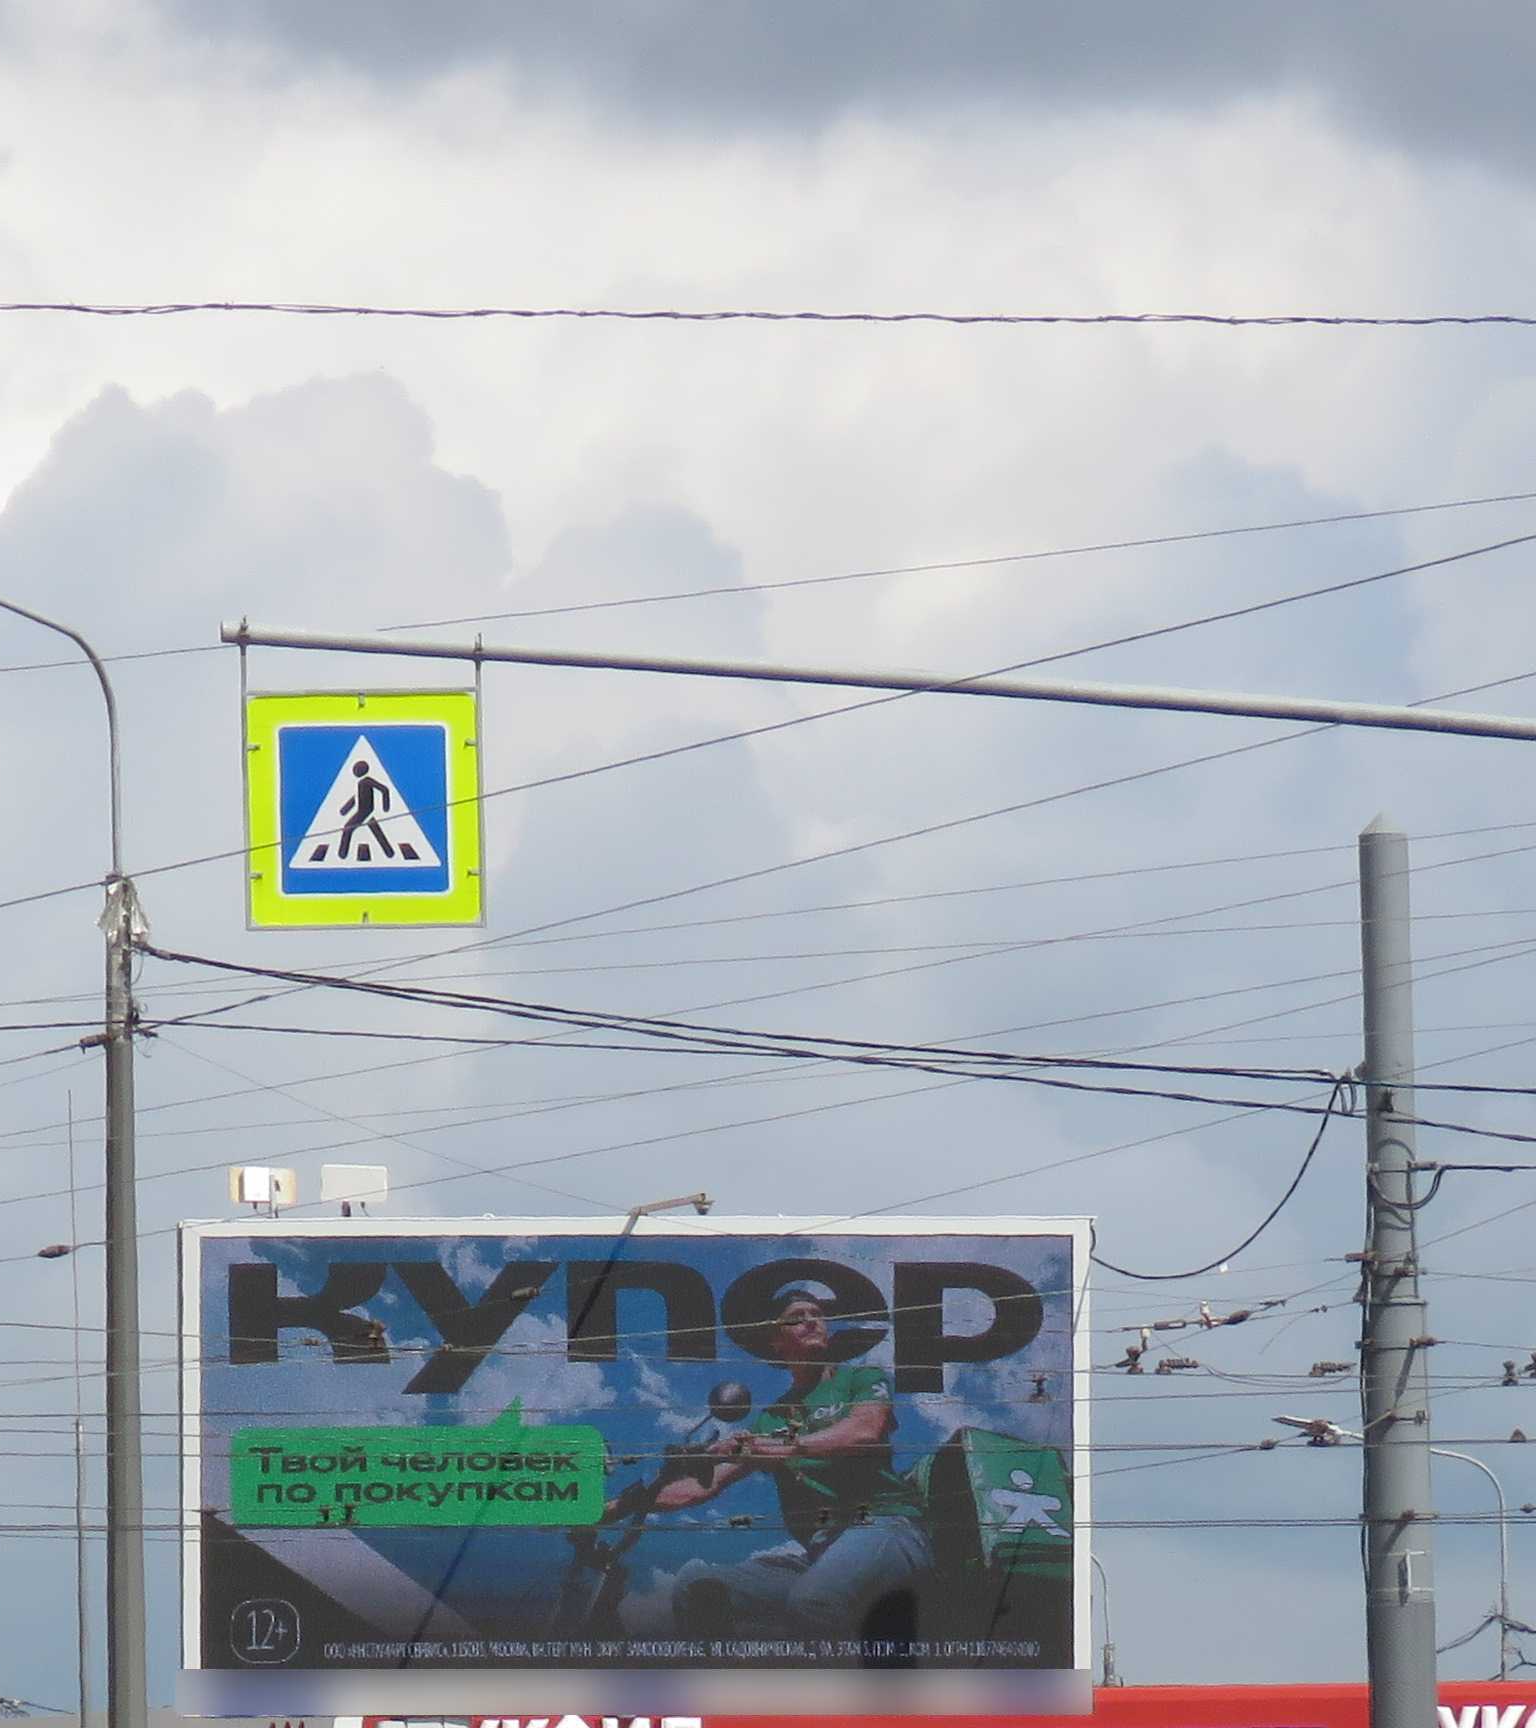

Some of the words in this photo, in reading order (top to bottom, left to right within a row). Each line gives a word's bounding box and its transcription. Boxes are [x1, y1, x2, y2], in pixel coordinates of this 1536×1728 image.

[248, 1446, 368, 1474] Твой
[380, 1450, 581, 1474] человек
[256, 1481, 318, 1504] по
[334, 1480, 580, 1508] покупкам
[246, 1608, 289, 1651] 12+
